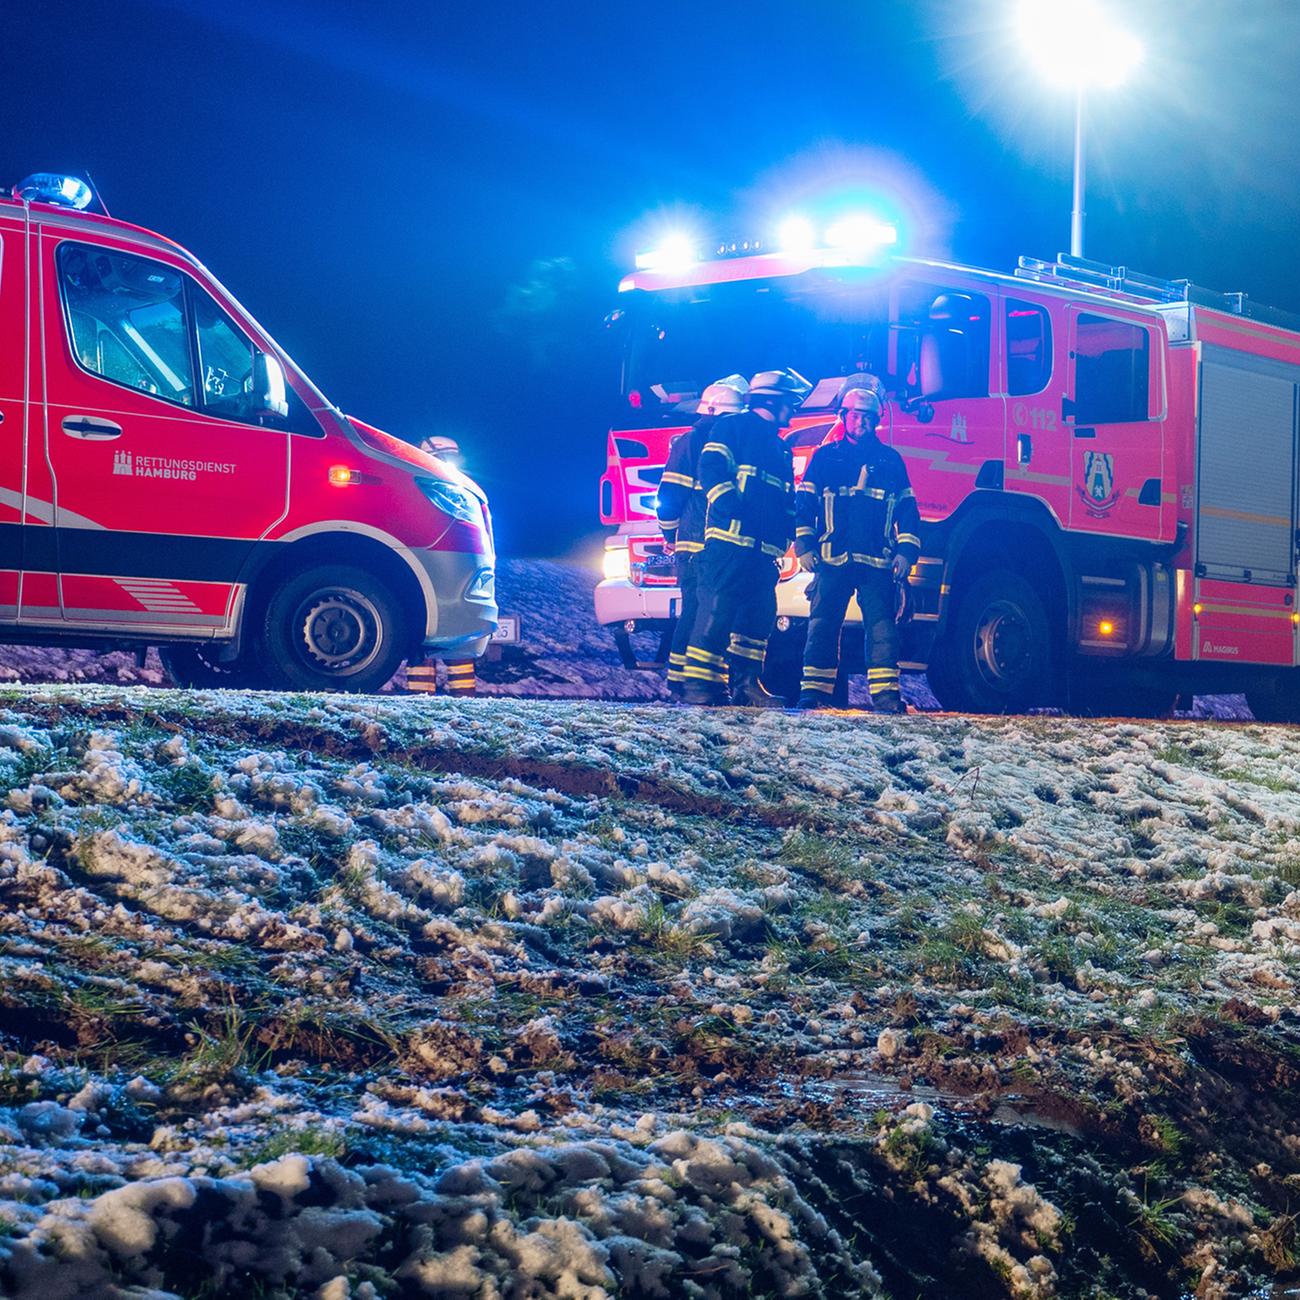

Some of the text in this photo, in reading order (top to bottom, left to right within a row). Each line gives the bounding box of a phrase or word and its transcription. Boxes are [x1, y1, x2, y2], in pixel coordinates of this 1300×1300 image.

[1030, 407, 1057, 431] 112
[135, 456, 237, 475] RETTUNGSDIENST
[135, 467, 197, 481] HAMBURG
